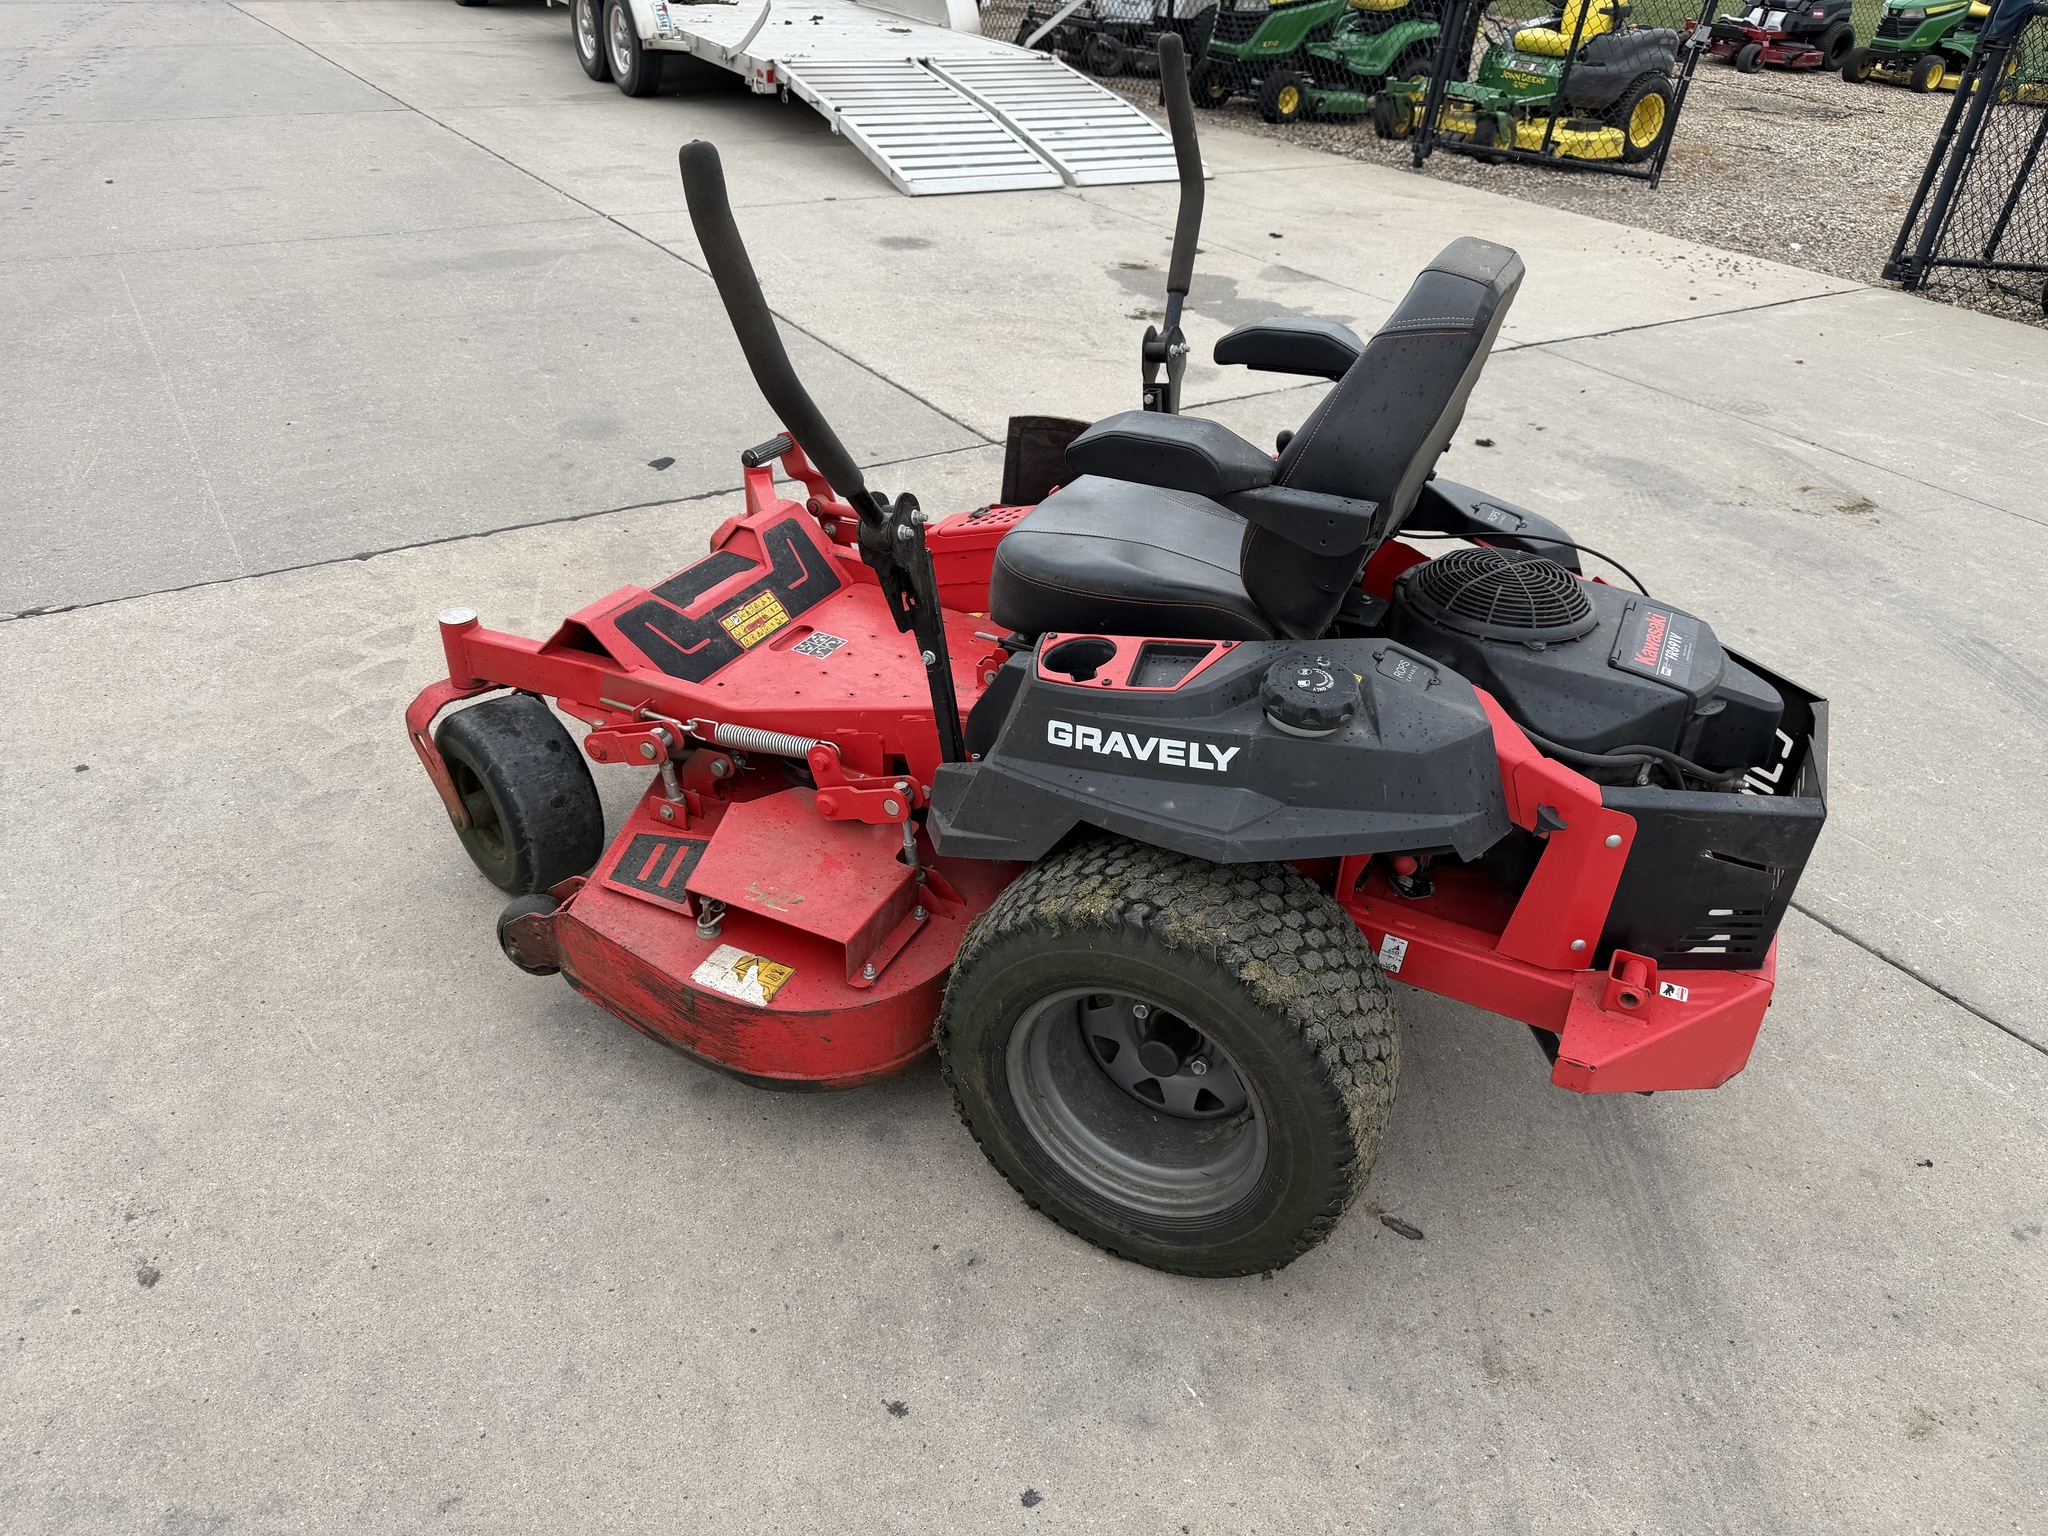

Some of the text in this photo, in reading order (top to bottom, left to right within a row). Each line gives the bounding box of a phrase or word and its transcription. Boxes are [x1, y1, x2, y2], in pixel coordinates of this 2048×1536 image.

[1634, 612, 1667, 667] Kawasaki
[1665, 631, 1683, 661] FR691V
[1393, 659, 1410, 679] ROPS
[1047, 719, 1241, 772] GRAVELY
